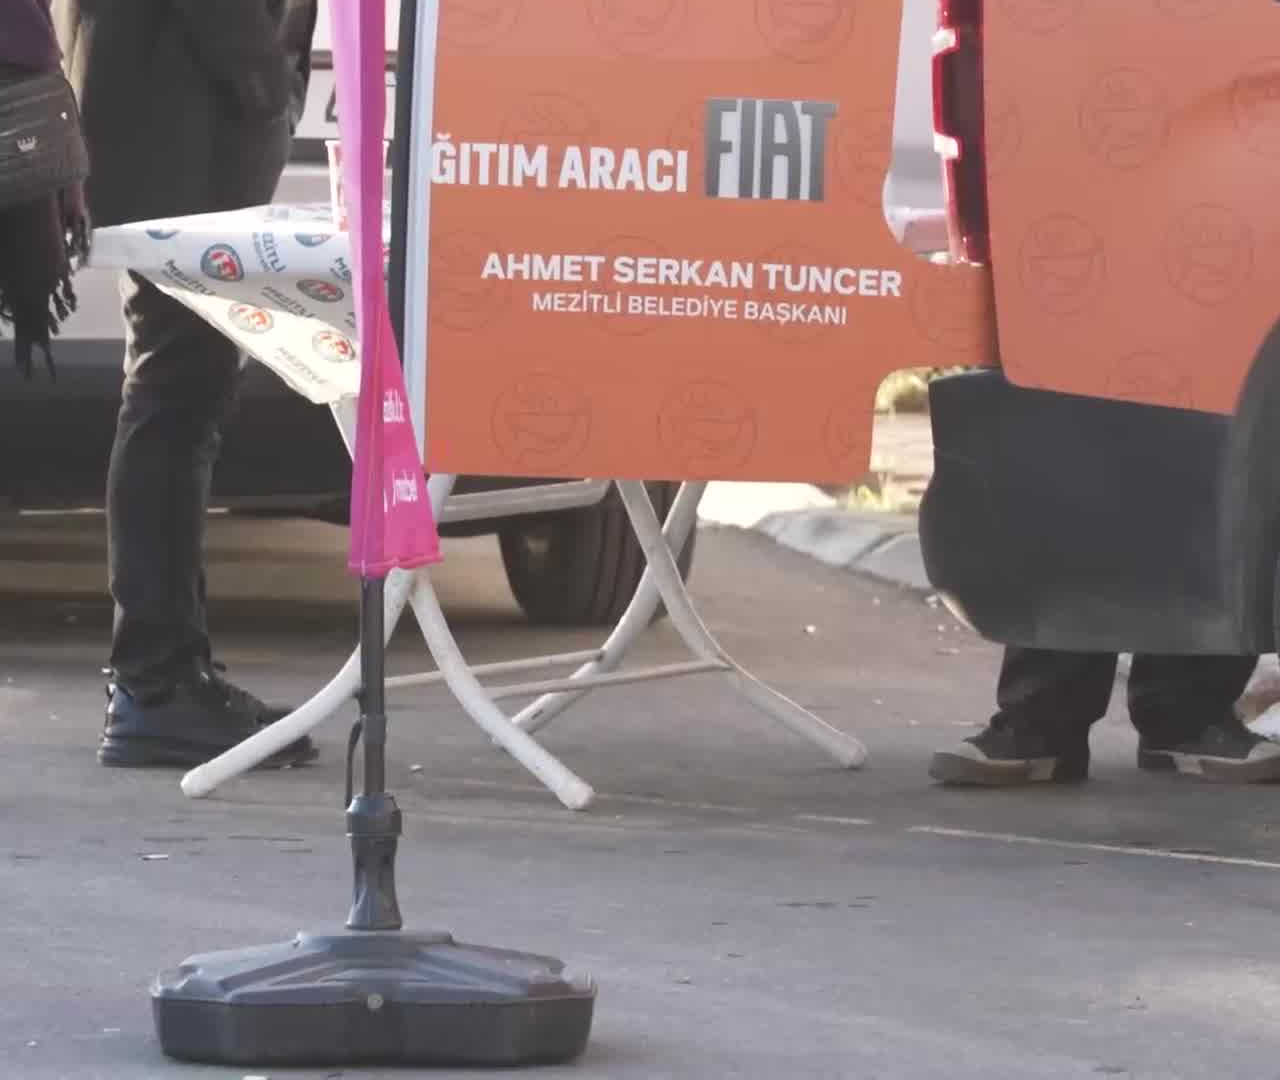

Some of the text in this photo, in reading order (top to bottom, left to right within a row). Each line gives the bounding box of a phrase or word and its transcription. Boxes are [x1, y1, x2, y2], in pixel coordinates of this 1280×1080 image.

[430, 132, 689, 194] ĞITIM ARACI
[705, 97, 839, 202] FIAT
[480, 252, 903, 298] AHMET SERKAN TUNCER
[532, 290, 848, 326] MEZİTLİ BELEDİYE BAŞKANI
